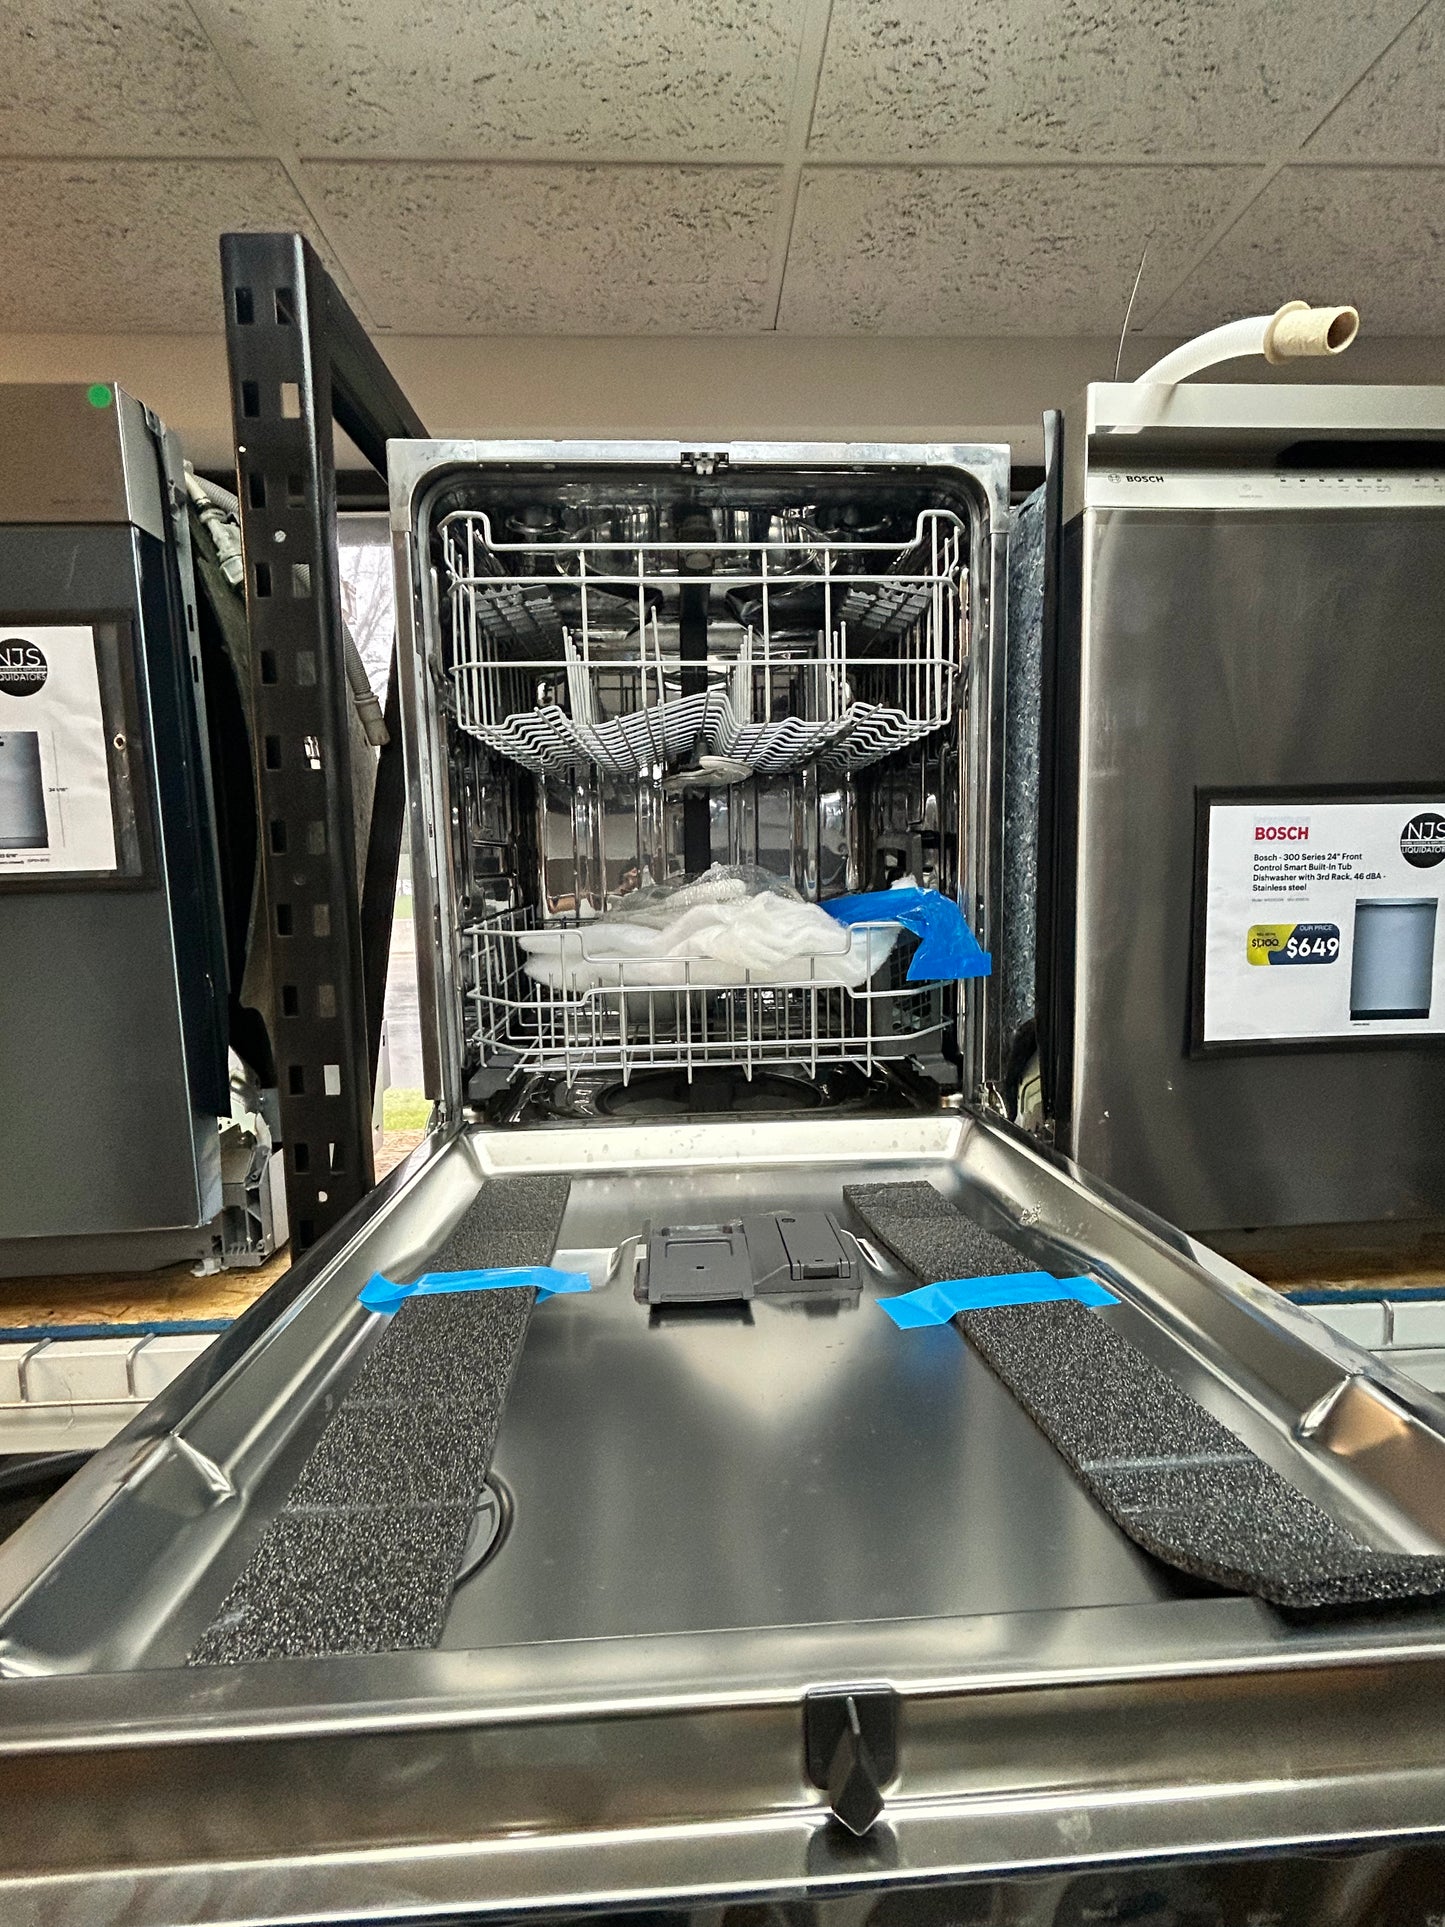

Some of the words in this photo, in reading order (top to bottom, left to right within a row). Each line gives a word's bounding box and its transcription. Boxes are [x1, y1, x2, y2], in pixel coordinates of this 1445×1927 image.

[1126, 475, 1164, 483] BOSCH
[1254, 826, 1309, 841] BOSCH
[1253, 853, 1278, 861] Bosch
[1283, 853, 1300, 861] 300
[1301, 853, 1326, 861] Series
[1341, 852, 1363, 860] Front
[1253, 863, 1283, 871] Control
[1284, 863, 1307, 871] Smart
[1308, 863, 1337, 871] Built-In
[1338, 863, 1353, 871] Tub
[1253, 873, 1297, 881] Dishwasher
[1298, 873, 1315, 881] with
[1316, 873, 1330, 881] 3rd
[1331, 873, 1353, 881] Rack,
[1353, 872, 1365, 880] 46
[1365, 872, 1382, 880] dBA
[1252, 883, 1287, 891] Stainless
[1288, 883, 1307, 891] steel
[1286, 936, 1339, 959] $649
